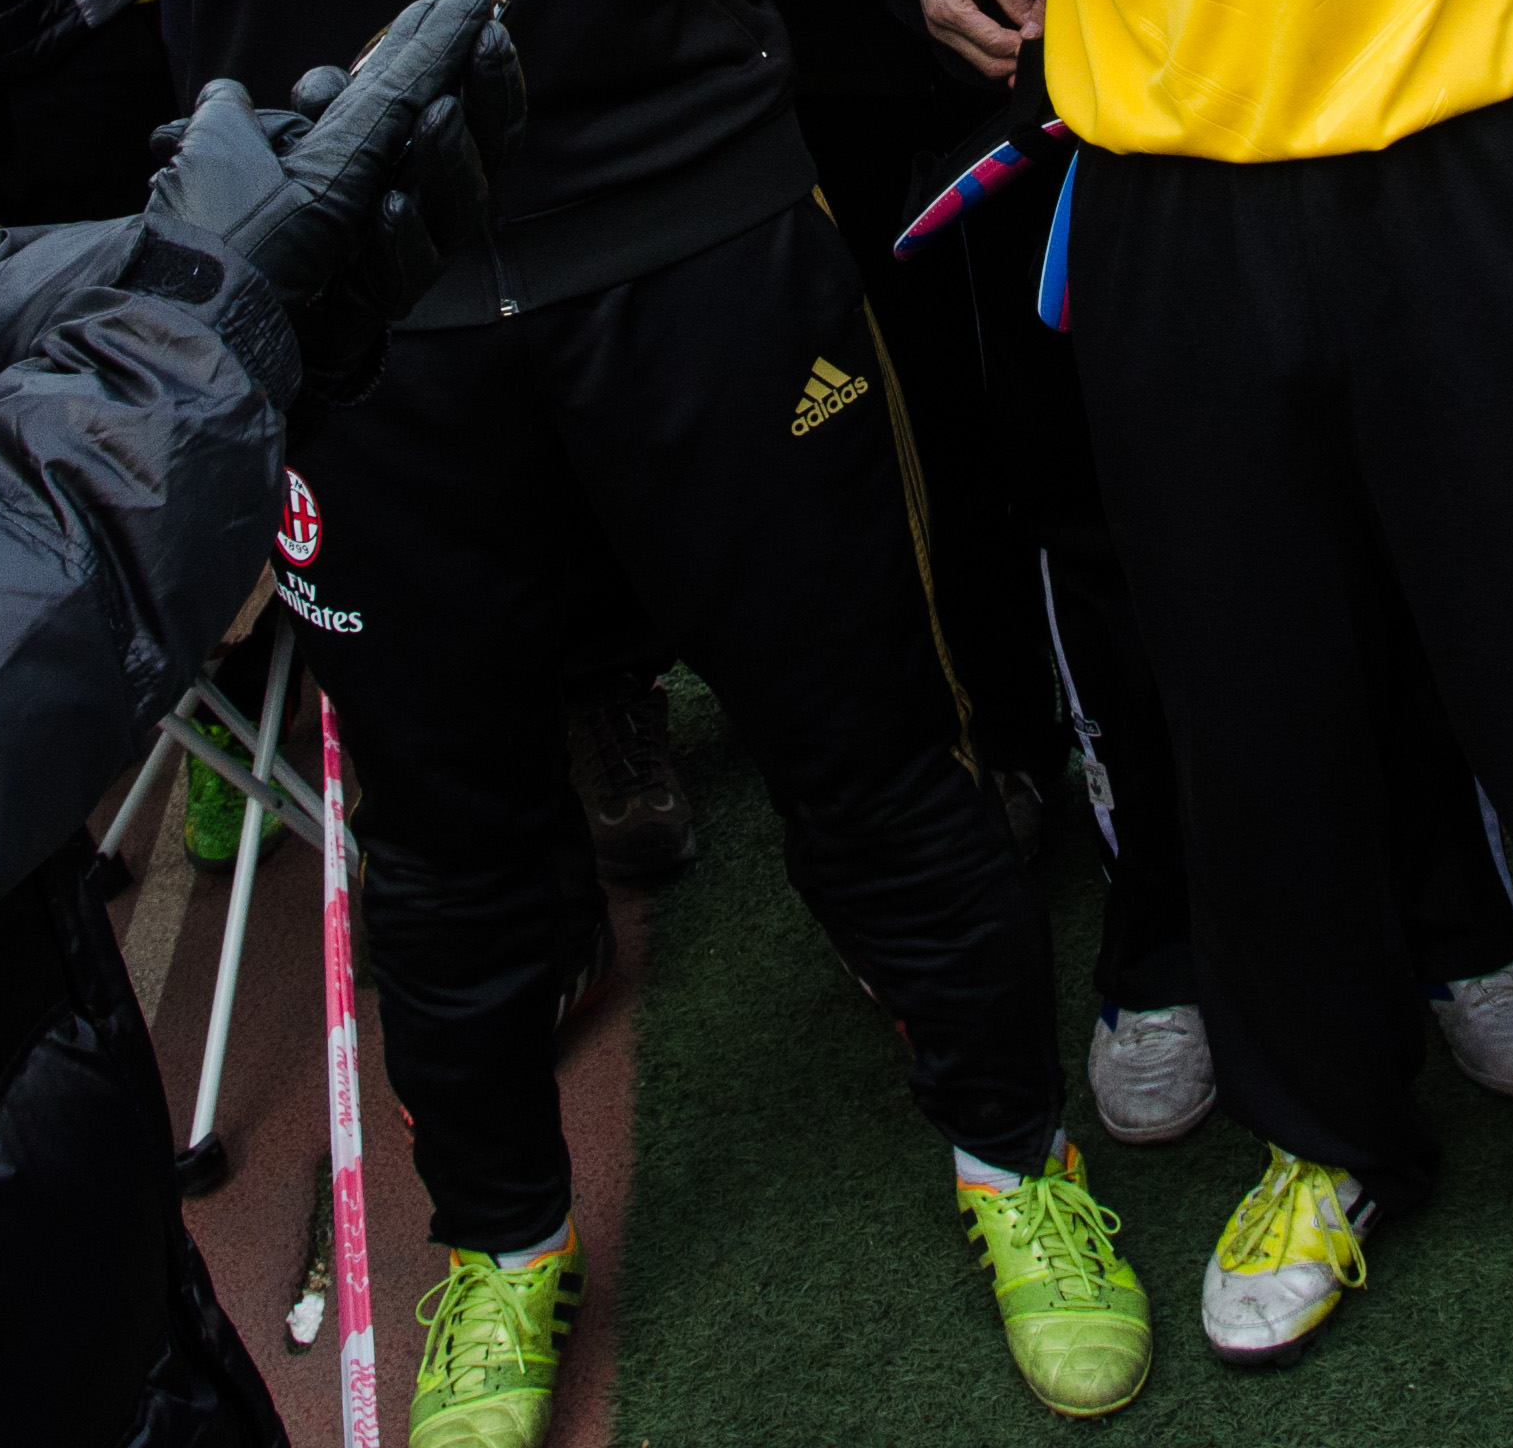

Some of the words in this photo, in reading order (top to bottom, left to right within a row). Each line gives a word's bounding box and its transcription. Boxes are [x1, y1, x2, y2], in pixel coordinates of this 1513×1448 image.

[791, 376, 869, 437] adidas
[283, 537, 309, 555] 1899
[286, 571, 316, 602] Fly
